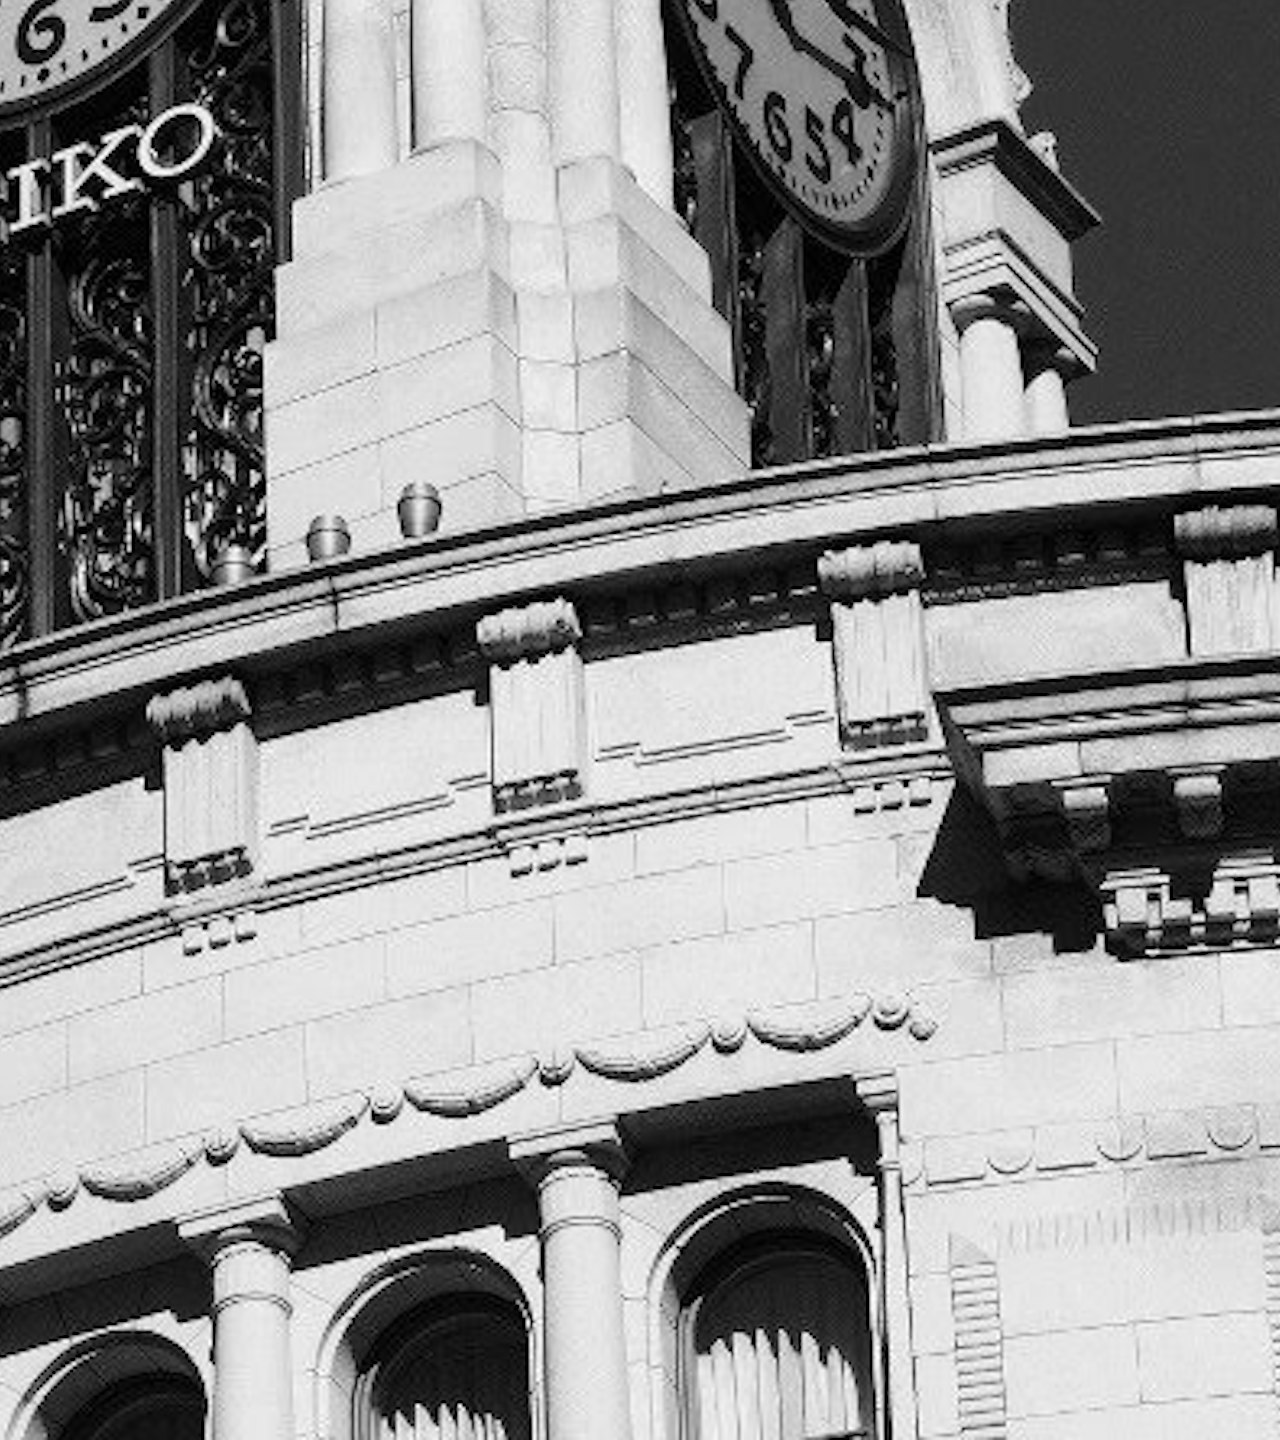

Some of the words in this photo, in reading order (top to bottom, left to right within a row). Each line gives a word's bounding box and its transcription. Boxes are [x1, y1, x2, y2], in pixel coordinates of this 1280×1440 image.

[725, 25, 753, 100] 7
[764, 91, 792, 161] 6
[806, 104, 831, 185] 5
[832, 98, 862, 167] 4
